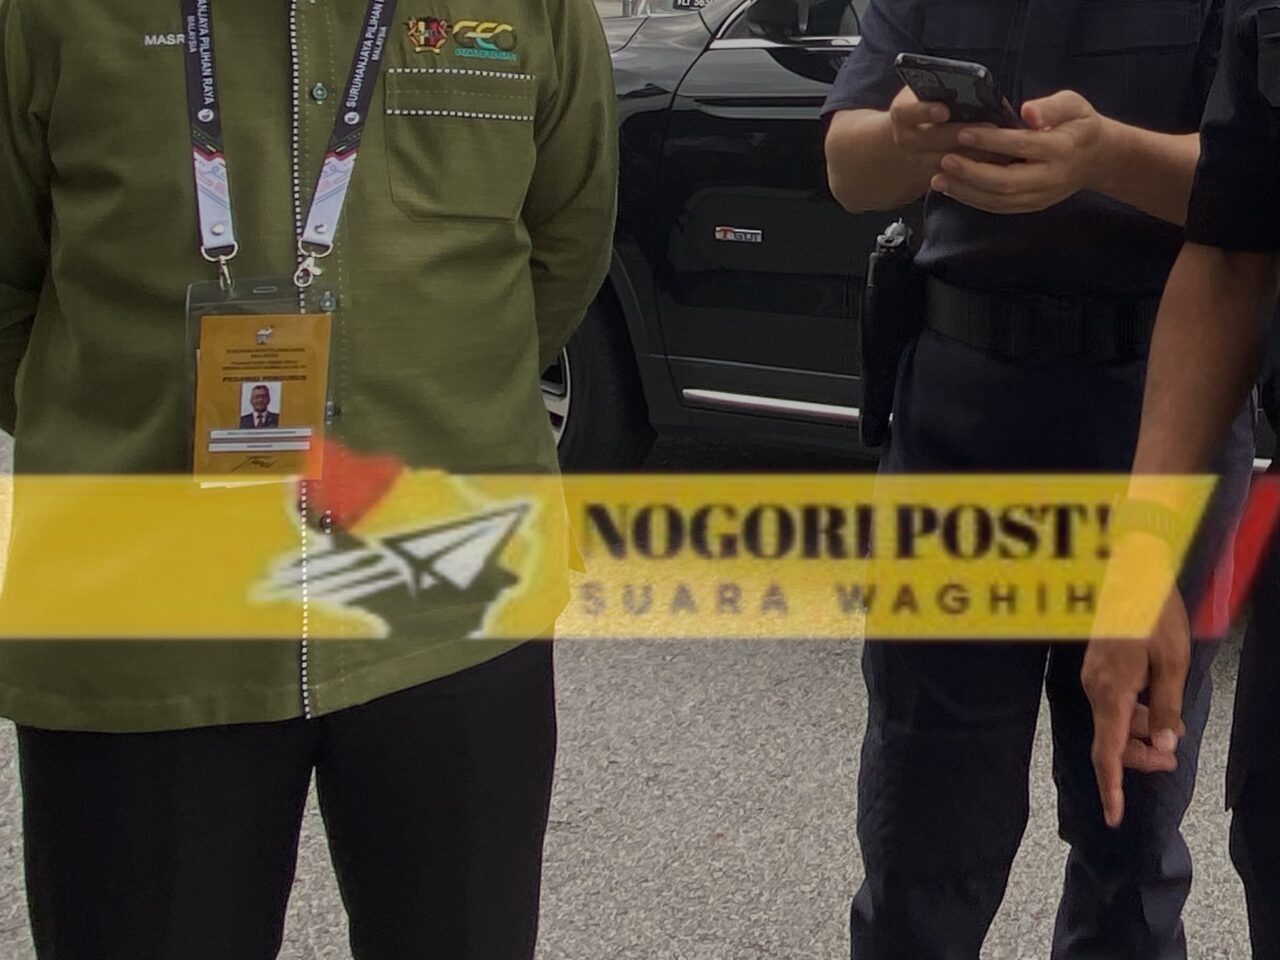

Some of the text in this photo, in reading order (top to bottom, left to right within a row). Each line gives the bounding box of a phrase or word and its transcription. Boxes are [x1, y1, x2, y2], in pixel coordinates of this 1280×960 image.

[187, 15, 198, 53] MALAYSIA
[371, 26, 387, 61] MALAYSIA
[199, 37, 212, 77] PILIHAN
[345, 40, 374, 108] SURUHANJAYA
[365, 3, 384, 39] PILIHAN
[202, 77, 215, 105] RAYA
